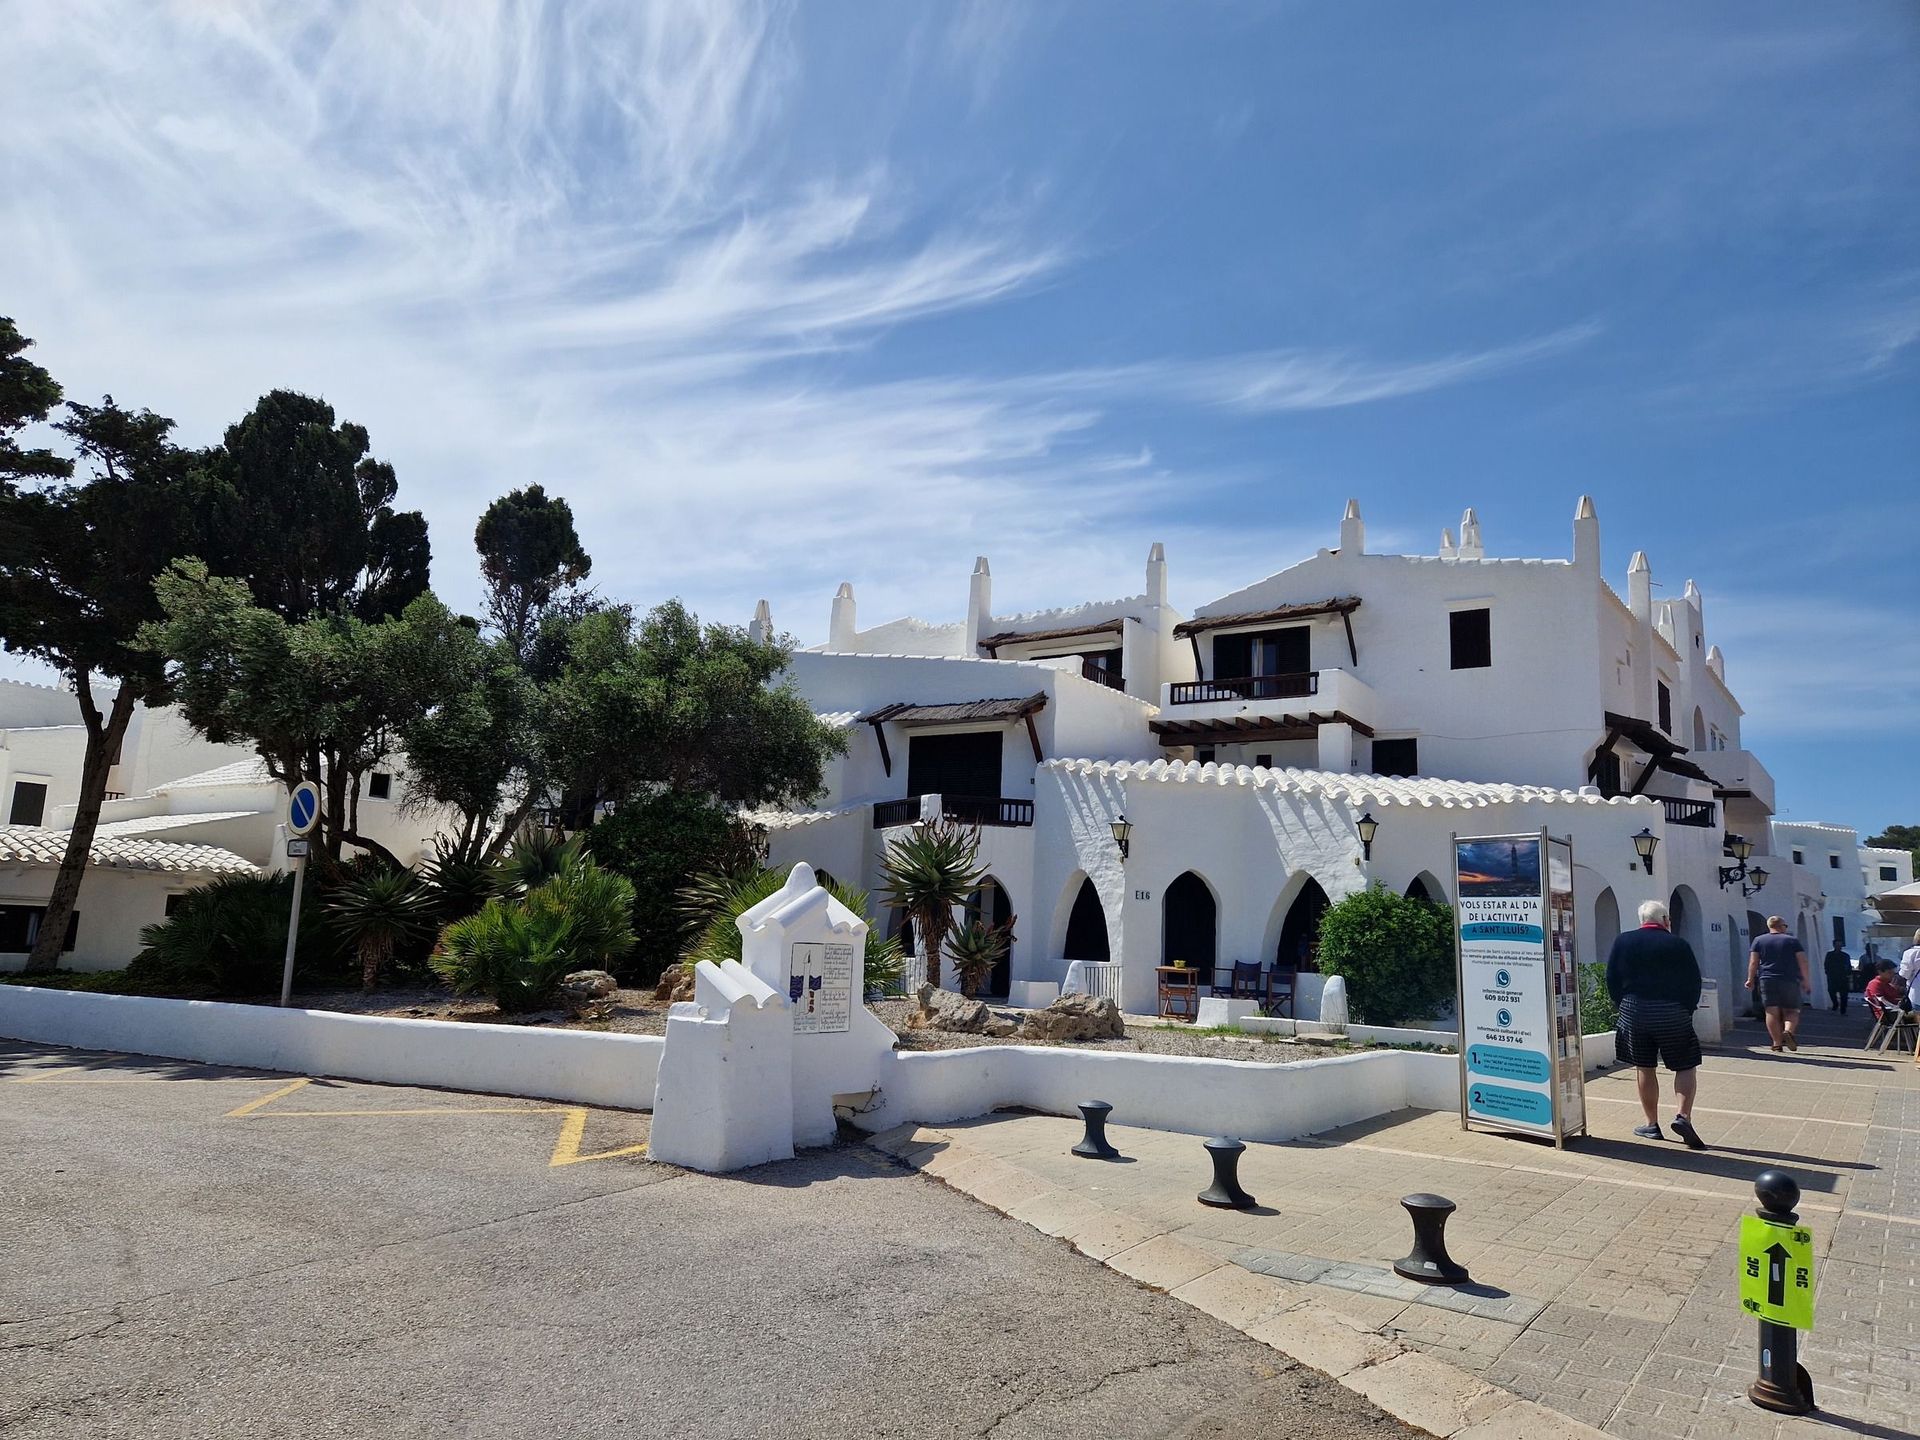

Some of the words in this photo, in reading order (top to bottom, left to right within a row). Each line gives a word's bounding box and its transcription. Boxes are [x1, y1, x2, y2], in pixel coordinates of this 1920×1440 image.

[1135, 890, 1151, 900] E16
[1460, 901, 1481, 909] VOLS
[1483, 901, 1507, 909] ESTAR
[1510, 901, 1520, 909] AL
[1522, 901, 1538, 909] DIA
[1468, 913, 1479, 921] DE
[1481, 913, 1529, 922] L'ACTIVITAT
[1471, 926, 1478, 934] A
[1480, 925, 1500, 934] SANT
[1498, 1034, 1506, 1042] 23
[1471, 1051, 1481, 1065] 1.
[1474, 1090, 1486, 1104] 2.
